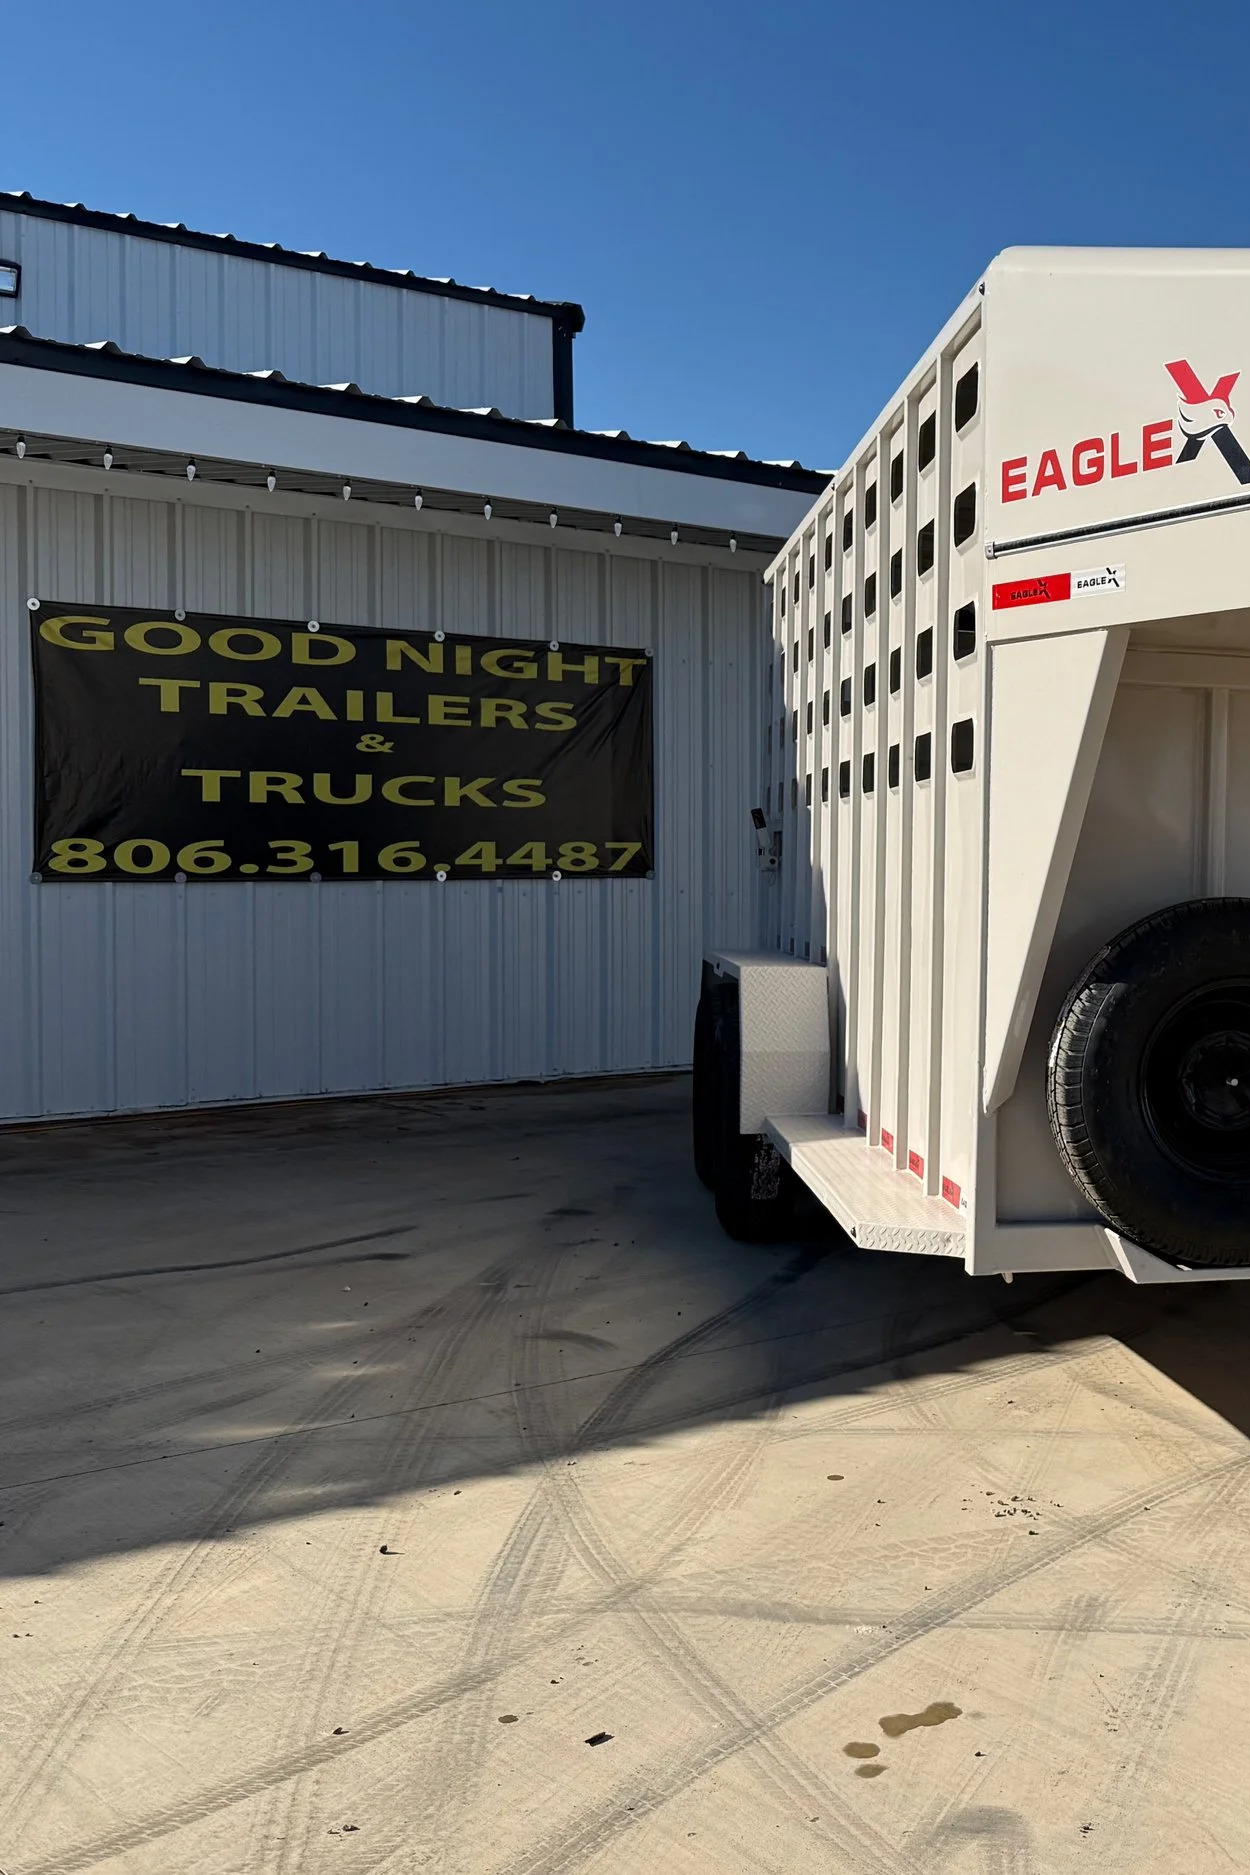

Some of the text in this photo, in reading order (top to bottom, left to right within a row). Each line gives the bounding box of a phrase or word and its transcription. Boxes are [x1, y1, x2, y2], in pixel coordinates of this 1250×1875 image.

[39, 615, 648, 687] GOOD NIGHT
[138, 677, 578, 731] TRAILERS
[355, 733, 395, 753] &
[180, 769, 547, 808] TRUCKS
[47, 837, 643, 874] 806.316.4487
